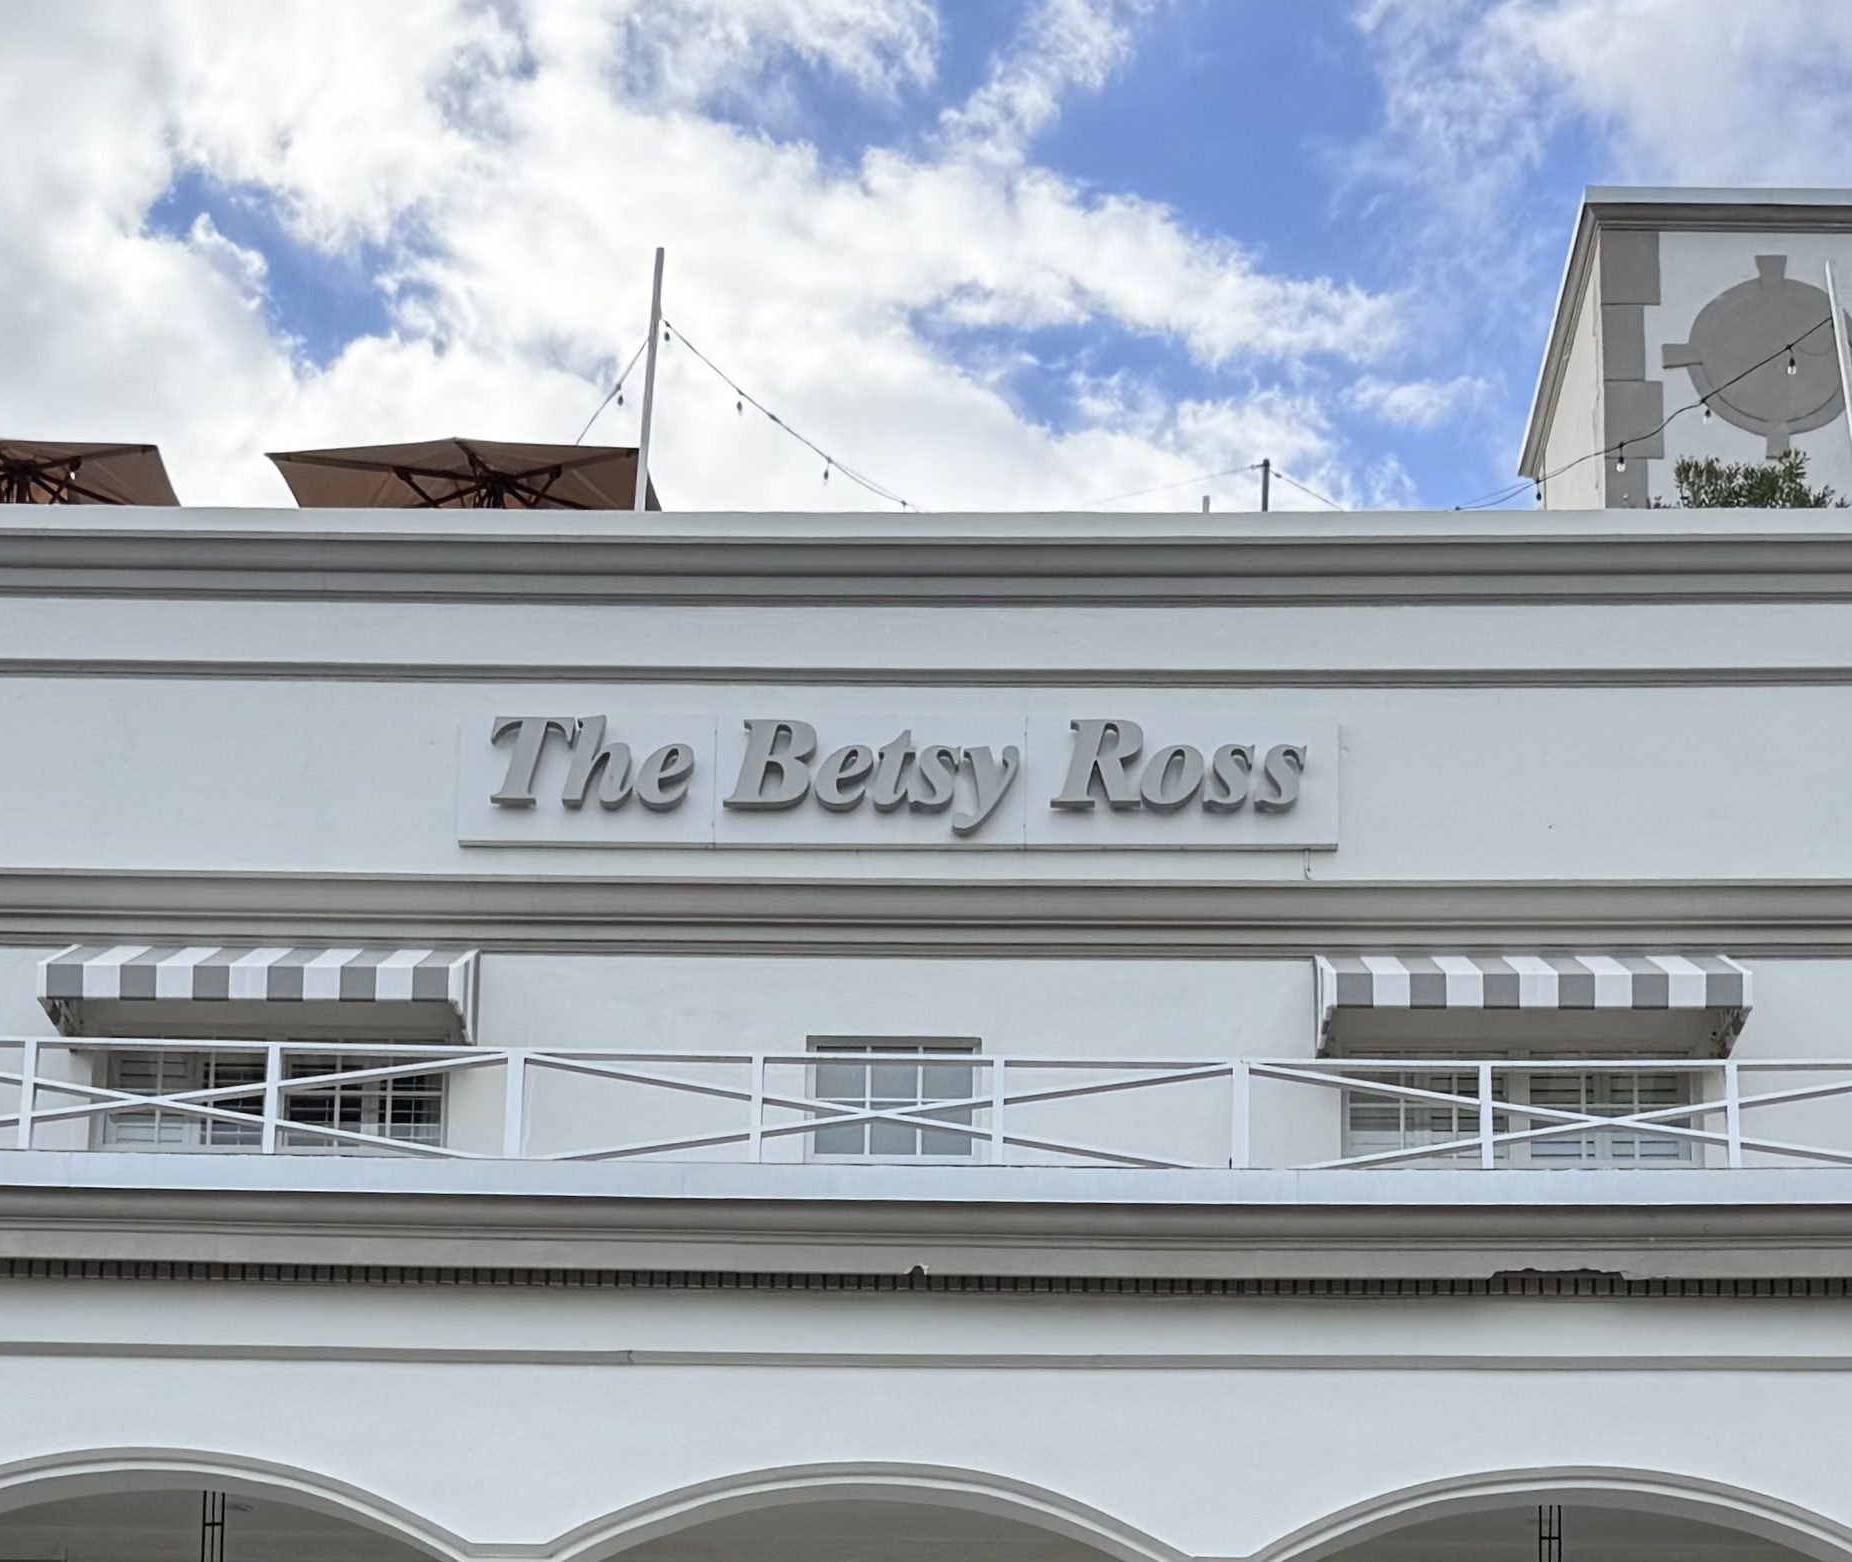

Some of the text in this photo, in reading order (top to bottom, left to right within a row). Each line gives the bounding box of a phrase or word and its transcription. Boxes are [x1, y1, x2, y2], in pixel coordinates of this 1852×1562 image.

[489, 714, 1307, 836] The Betsy Ross
